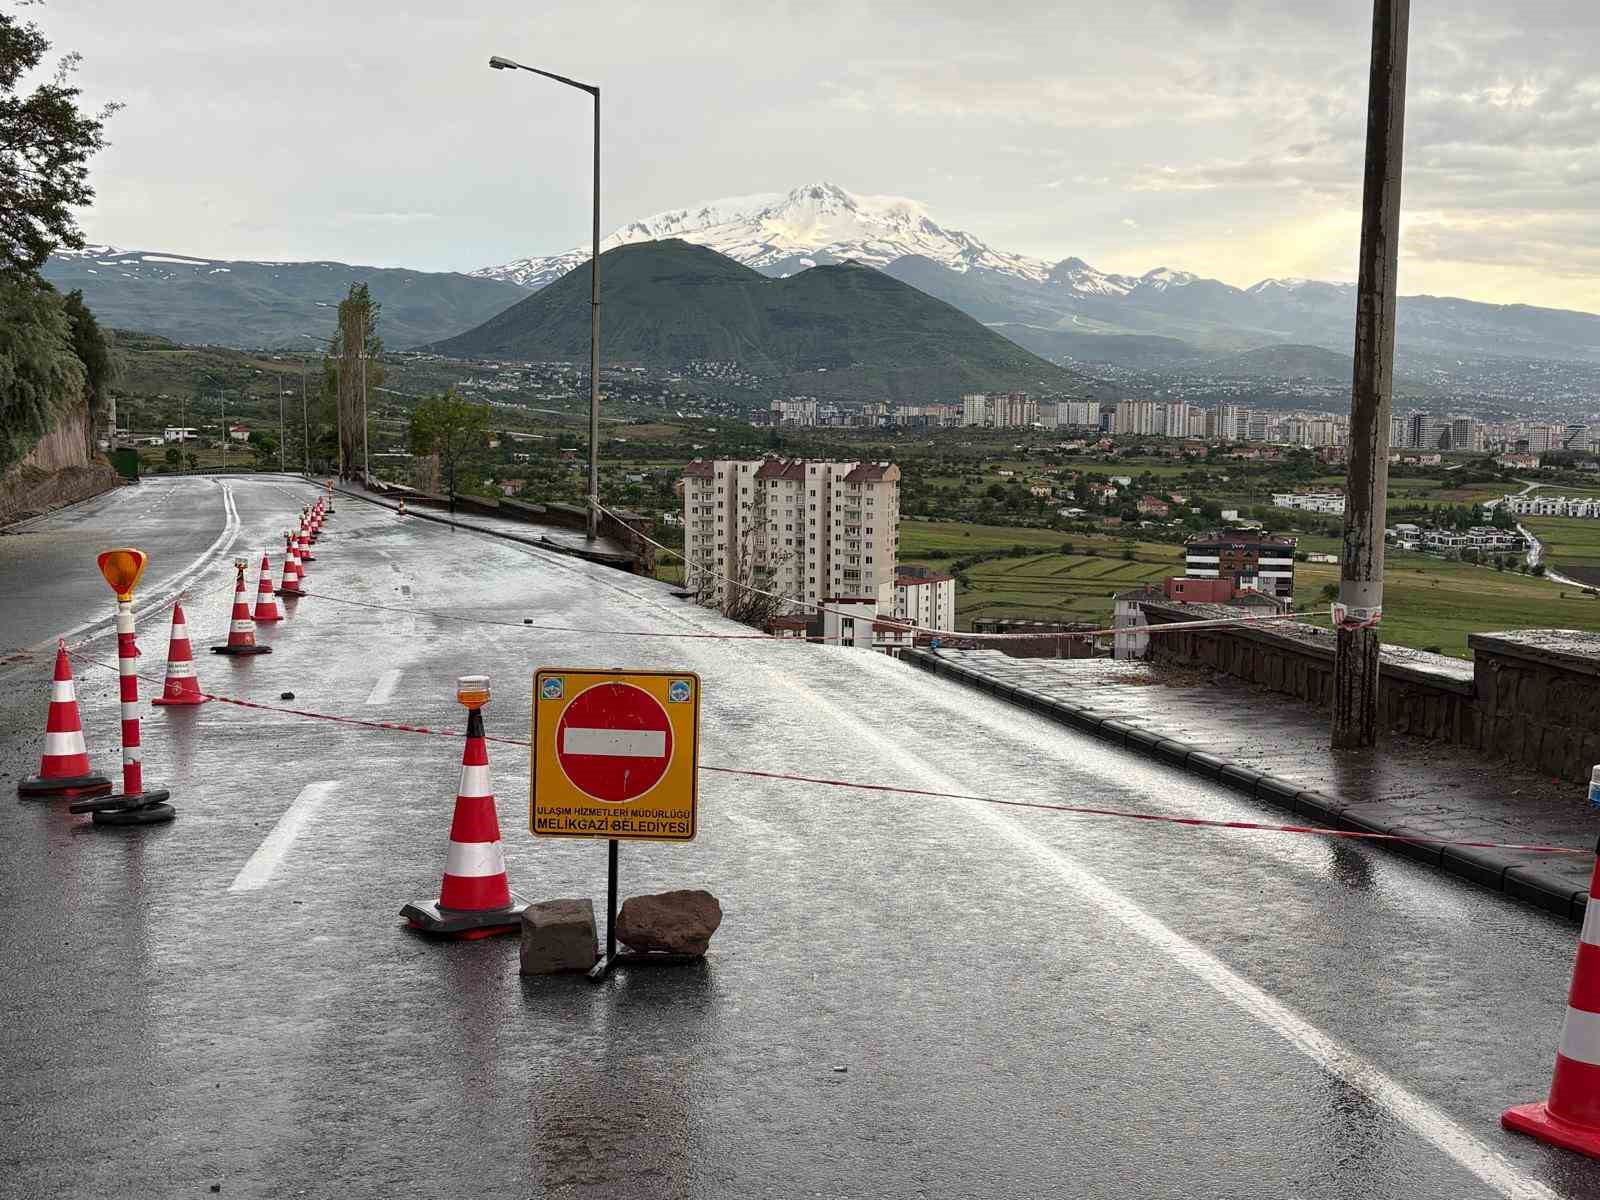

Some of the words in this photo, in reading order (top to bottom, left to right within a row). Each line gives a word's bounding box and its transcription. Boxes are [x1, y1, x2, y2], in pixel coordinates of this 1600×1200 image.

[537, 807, 571, 816] ULAŞIM
[575, 807, 629, 817] HİZMETLERİ
[537, 817, 608, 830] MELİKGAZİ
[612, 818, 689, 833] BELEDİYESİ
